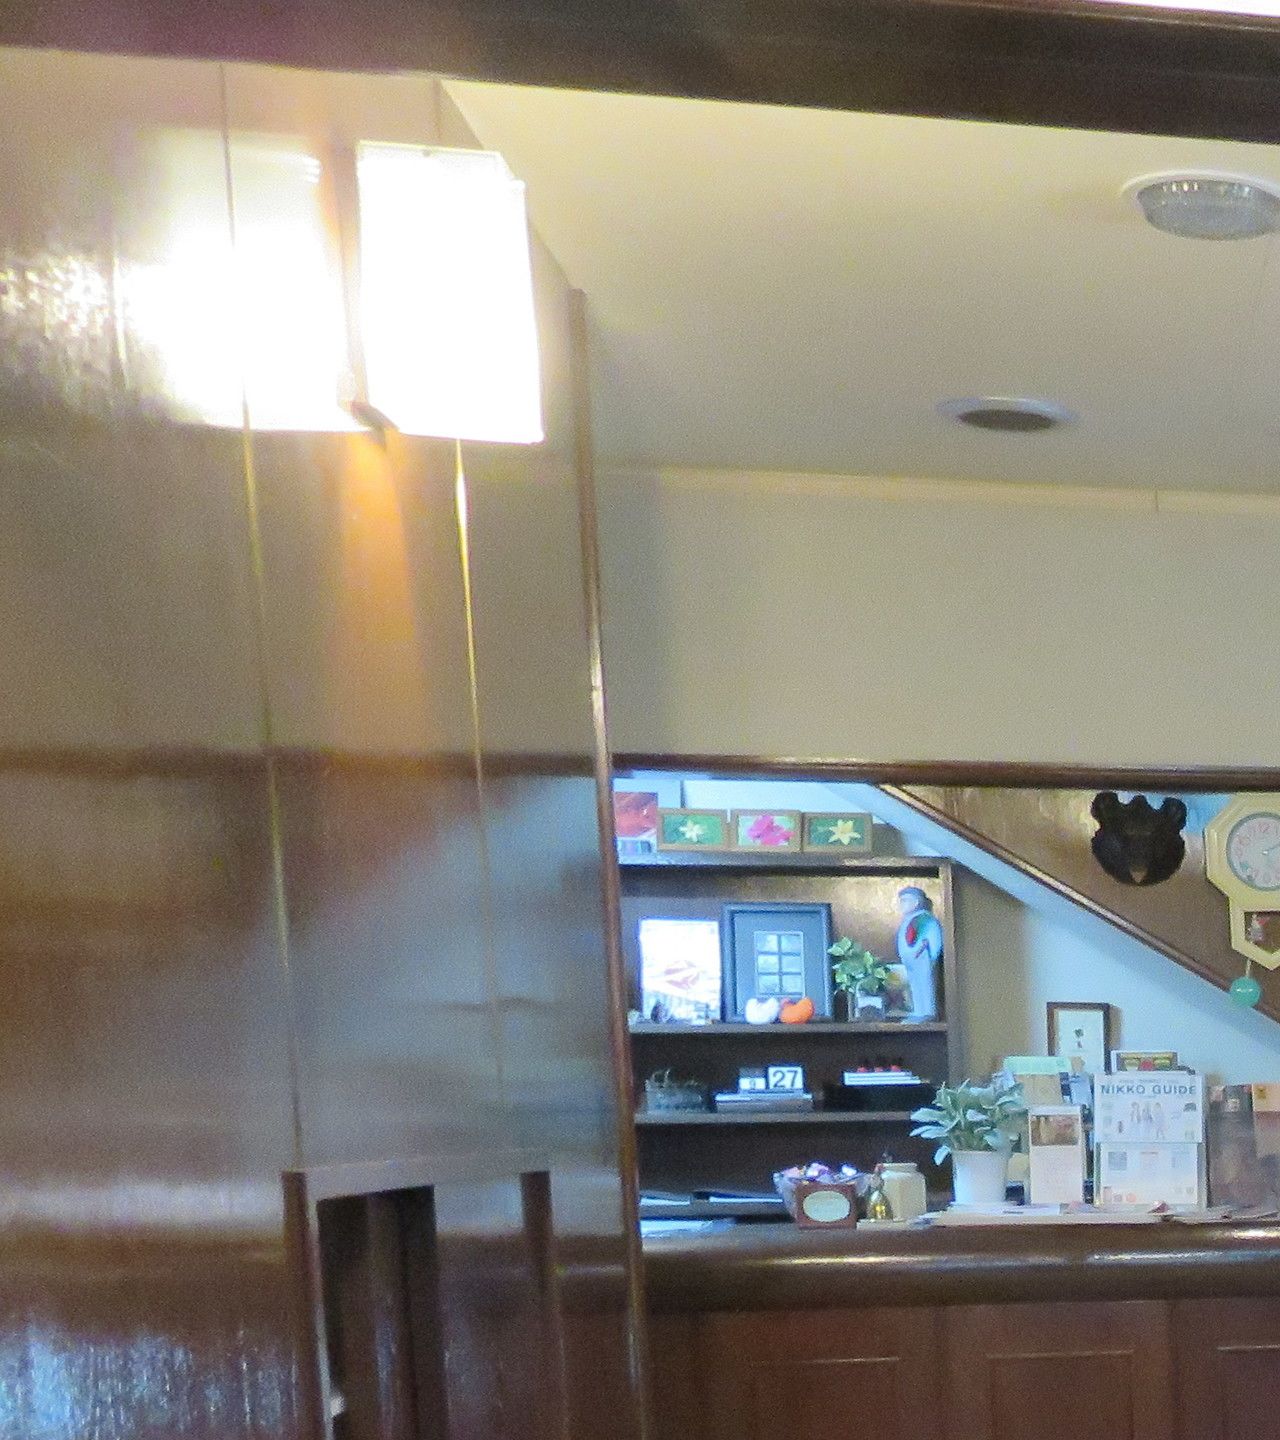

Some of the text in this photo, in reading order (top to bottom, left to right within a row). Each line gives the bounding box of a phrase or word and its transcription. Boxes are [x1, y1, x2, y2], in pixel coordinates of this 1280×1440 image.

[773, 1070, 798, 1088] 27
[1101, 1084, 1197, 1095] NIKKO GUIDE
